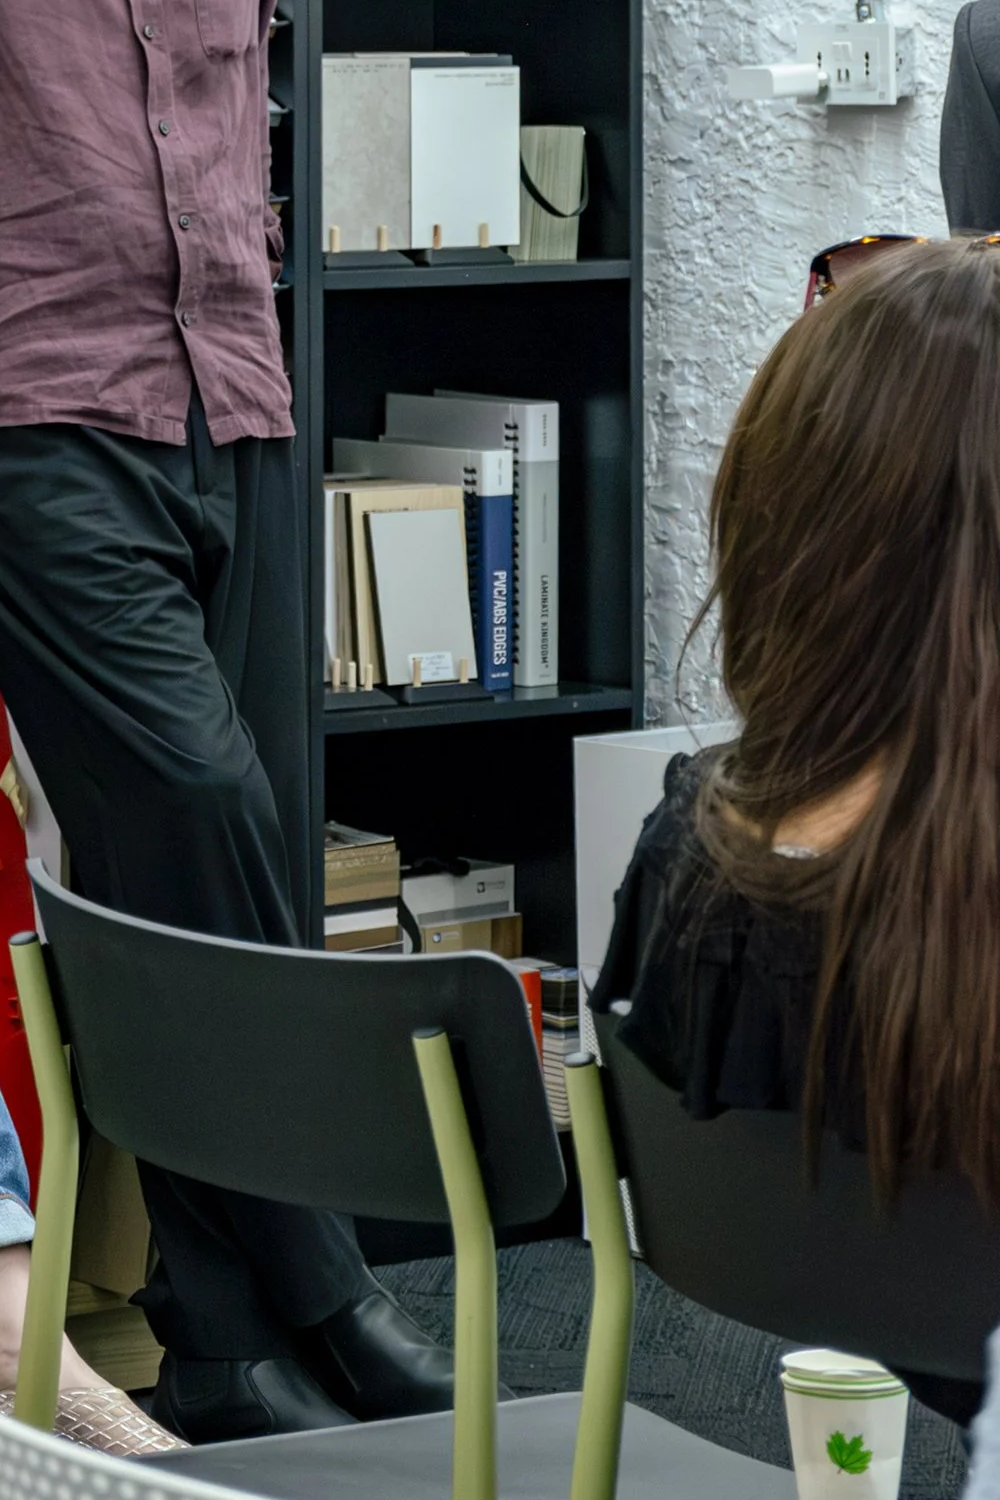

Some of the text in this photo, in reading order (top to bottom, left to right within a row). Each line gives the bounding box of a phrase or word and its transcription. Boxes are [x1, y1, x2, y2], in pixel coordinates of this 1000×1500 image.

[493, 570, 507, 625] PVC/ABS
[541, 574, 549, 618] LAMINATE
[493, 626, 507, 666] EDGES
